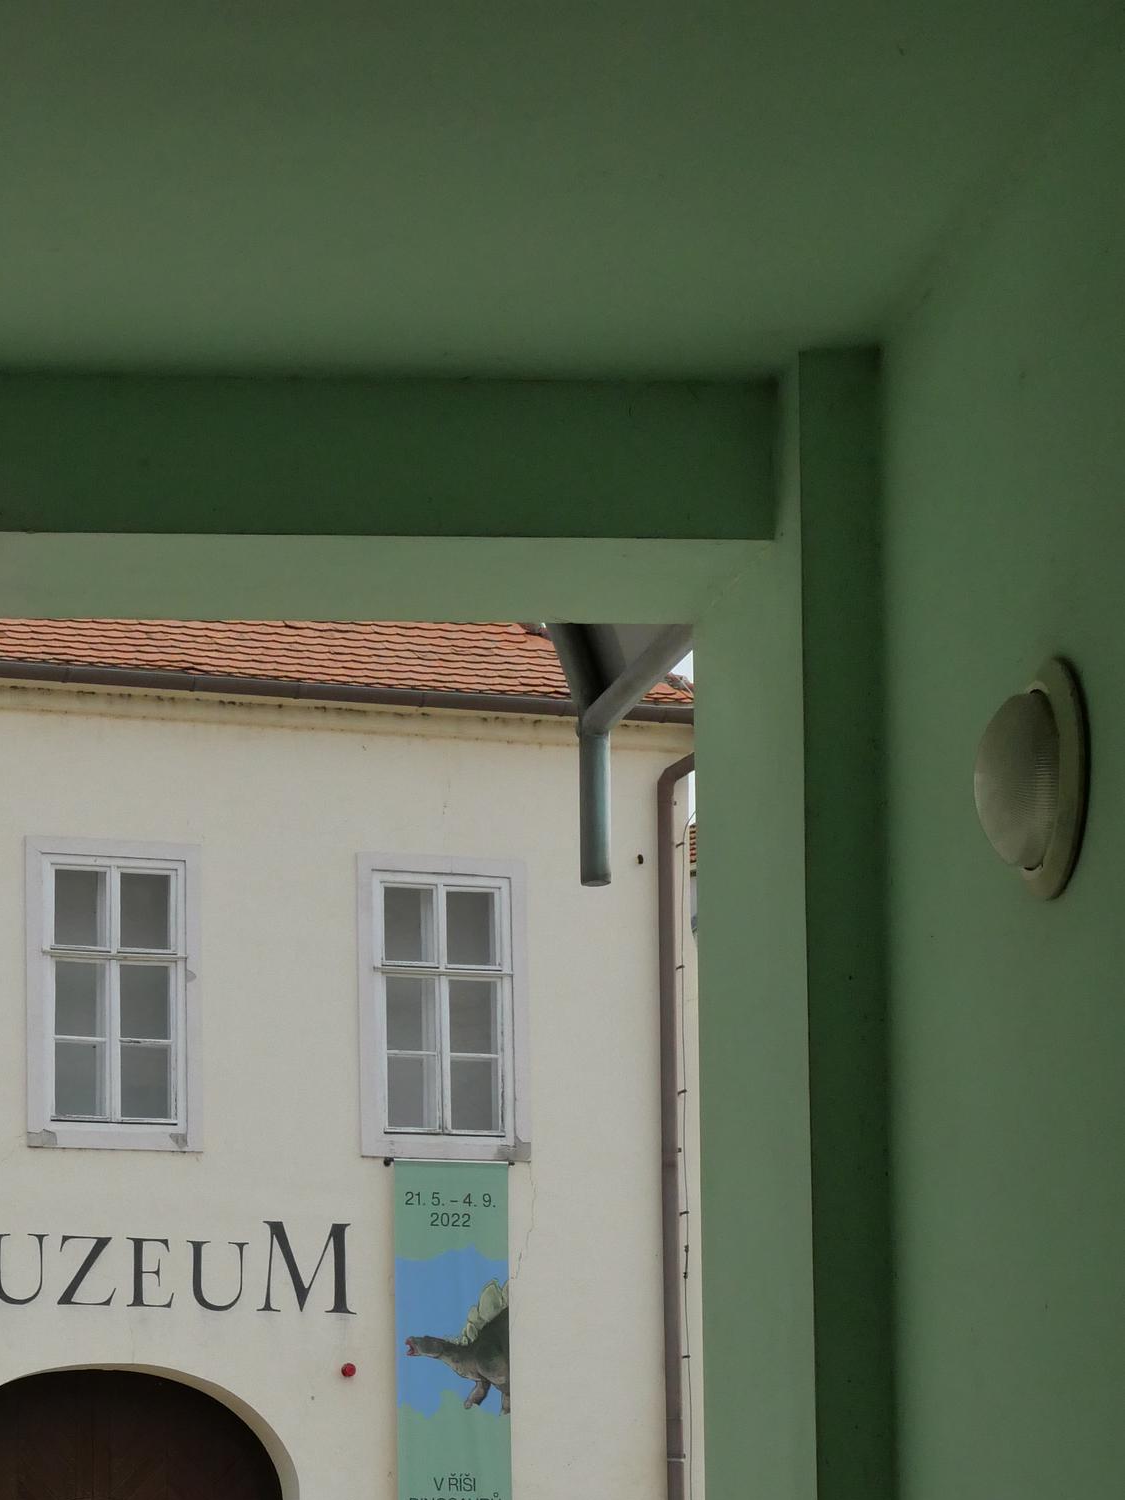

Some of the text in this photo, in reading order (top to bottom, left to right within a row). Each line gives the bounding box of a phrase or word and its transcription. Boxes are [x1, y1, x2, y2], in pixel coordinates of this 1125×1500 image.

[404, 1191, 426, 1206] 21.
[431, 1192, 445, 1206] 5.
[463, 1193, 477, 1207] 4.
[482, 1193, 496, 1208] 9.
[430, 1212, 471, 1227] 2022
[433, 1473, 476, 1492] V ŘÍŠI
